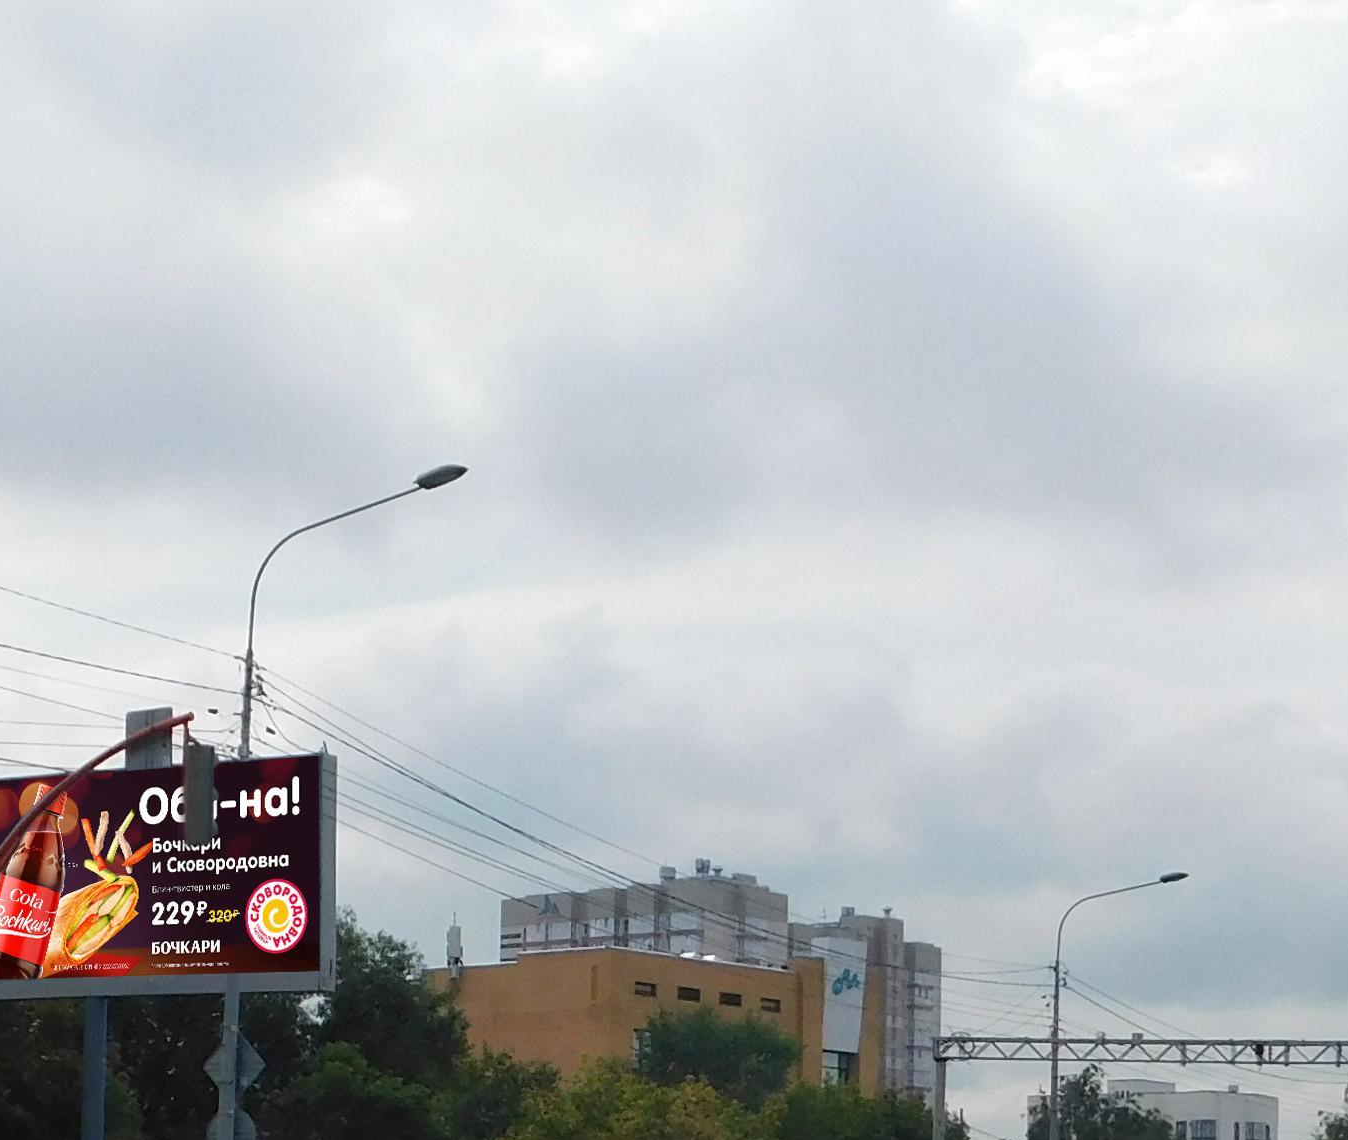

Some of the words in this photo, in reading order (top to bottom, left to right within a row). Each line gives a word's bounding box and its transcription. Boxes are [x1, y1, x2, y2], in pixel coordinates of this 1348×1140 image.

[139, 776, 300, 825] Об-на!
[152, 861, 161, 873] и
[167, 854, 289, 875] Сковородовна
[212, 883, 231, 891] кола
[9, 888, 44, 910] Cola
[250, 884, 304, 949] СКОВОРОДОВНА
[151, 939, 221, 955] БОЧКАРИ
